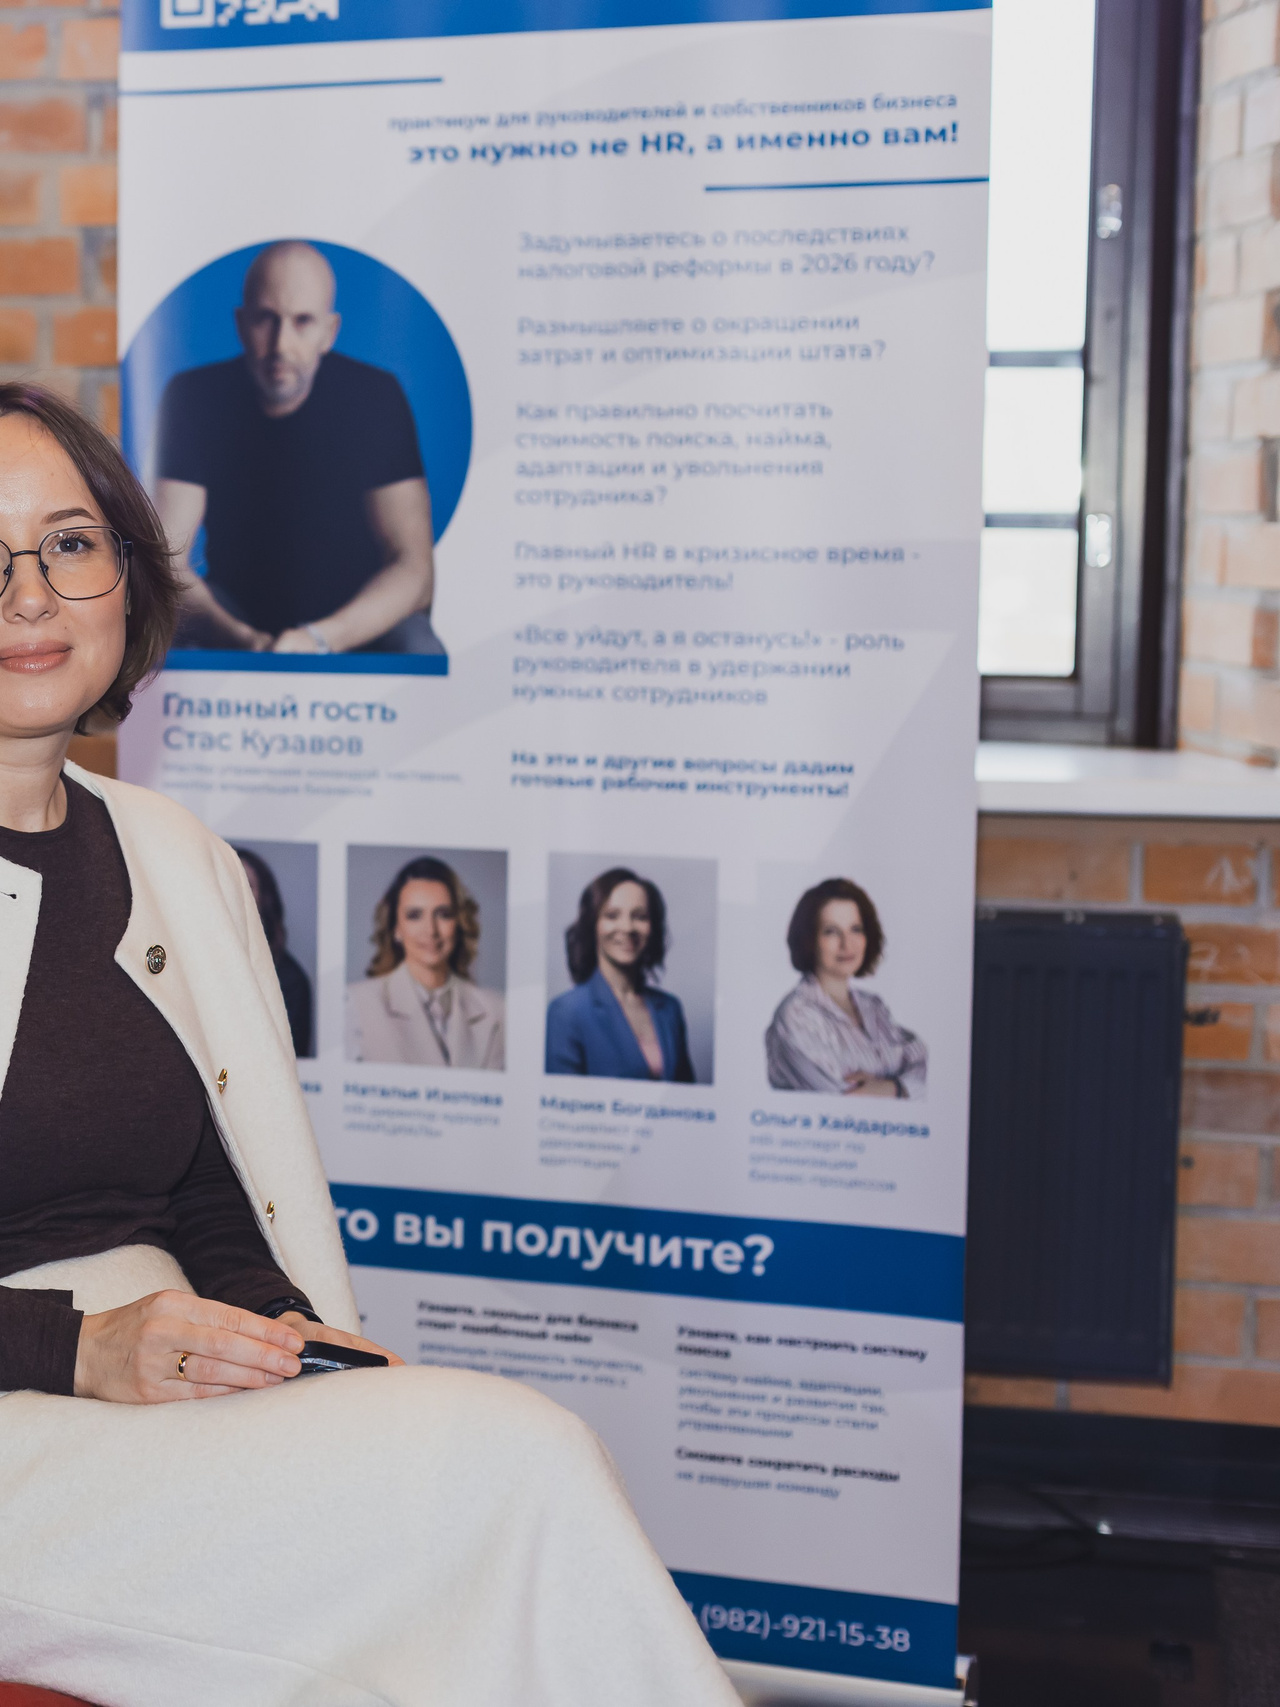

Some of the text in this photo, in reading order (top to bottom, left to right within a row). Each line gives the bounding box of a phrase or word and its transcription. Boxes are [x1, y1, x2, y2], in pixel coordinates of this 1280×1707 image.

[408, 122, 959, 166] это нужно не HR, а именно вам!
[162, 693, 398, 723] Главный гость
[162, 726, 364, 760] Стас Кузавов
[332, 1208, 774, 1277] то вы получите?
[700, 1602, 911, 1653] (982)-921-15-38
